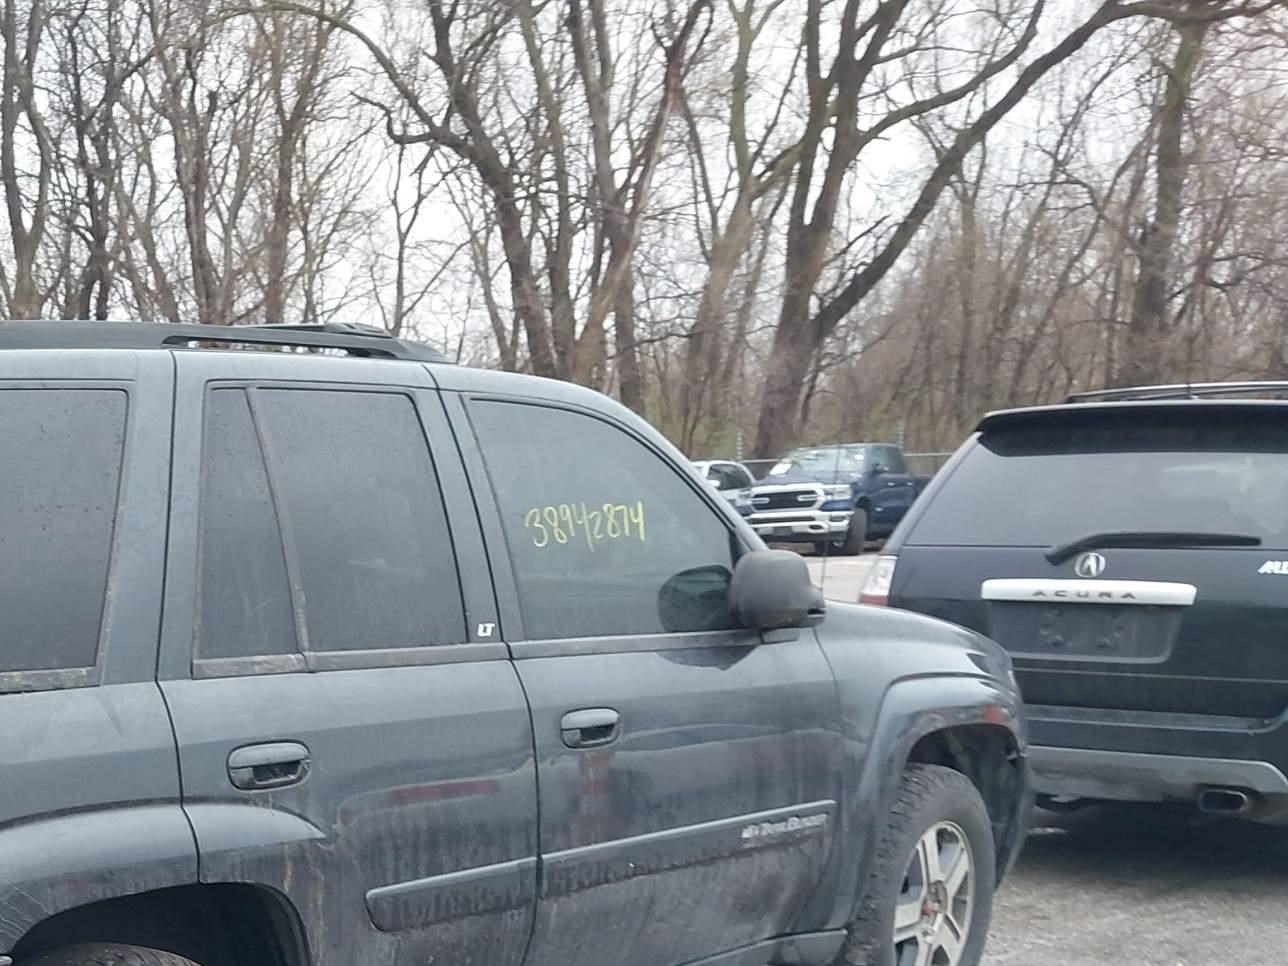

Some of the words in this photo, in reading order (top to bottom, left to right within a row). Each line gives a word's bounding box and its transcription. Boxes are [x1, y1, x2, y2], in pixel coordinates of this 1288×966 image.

[524, 500, 645, 552] 38942874
[1032, 590, 1136, 599] ACURA
[477, 623, 495, 637] LT
